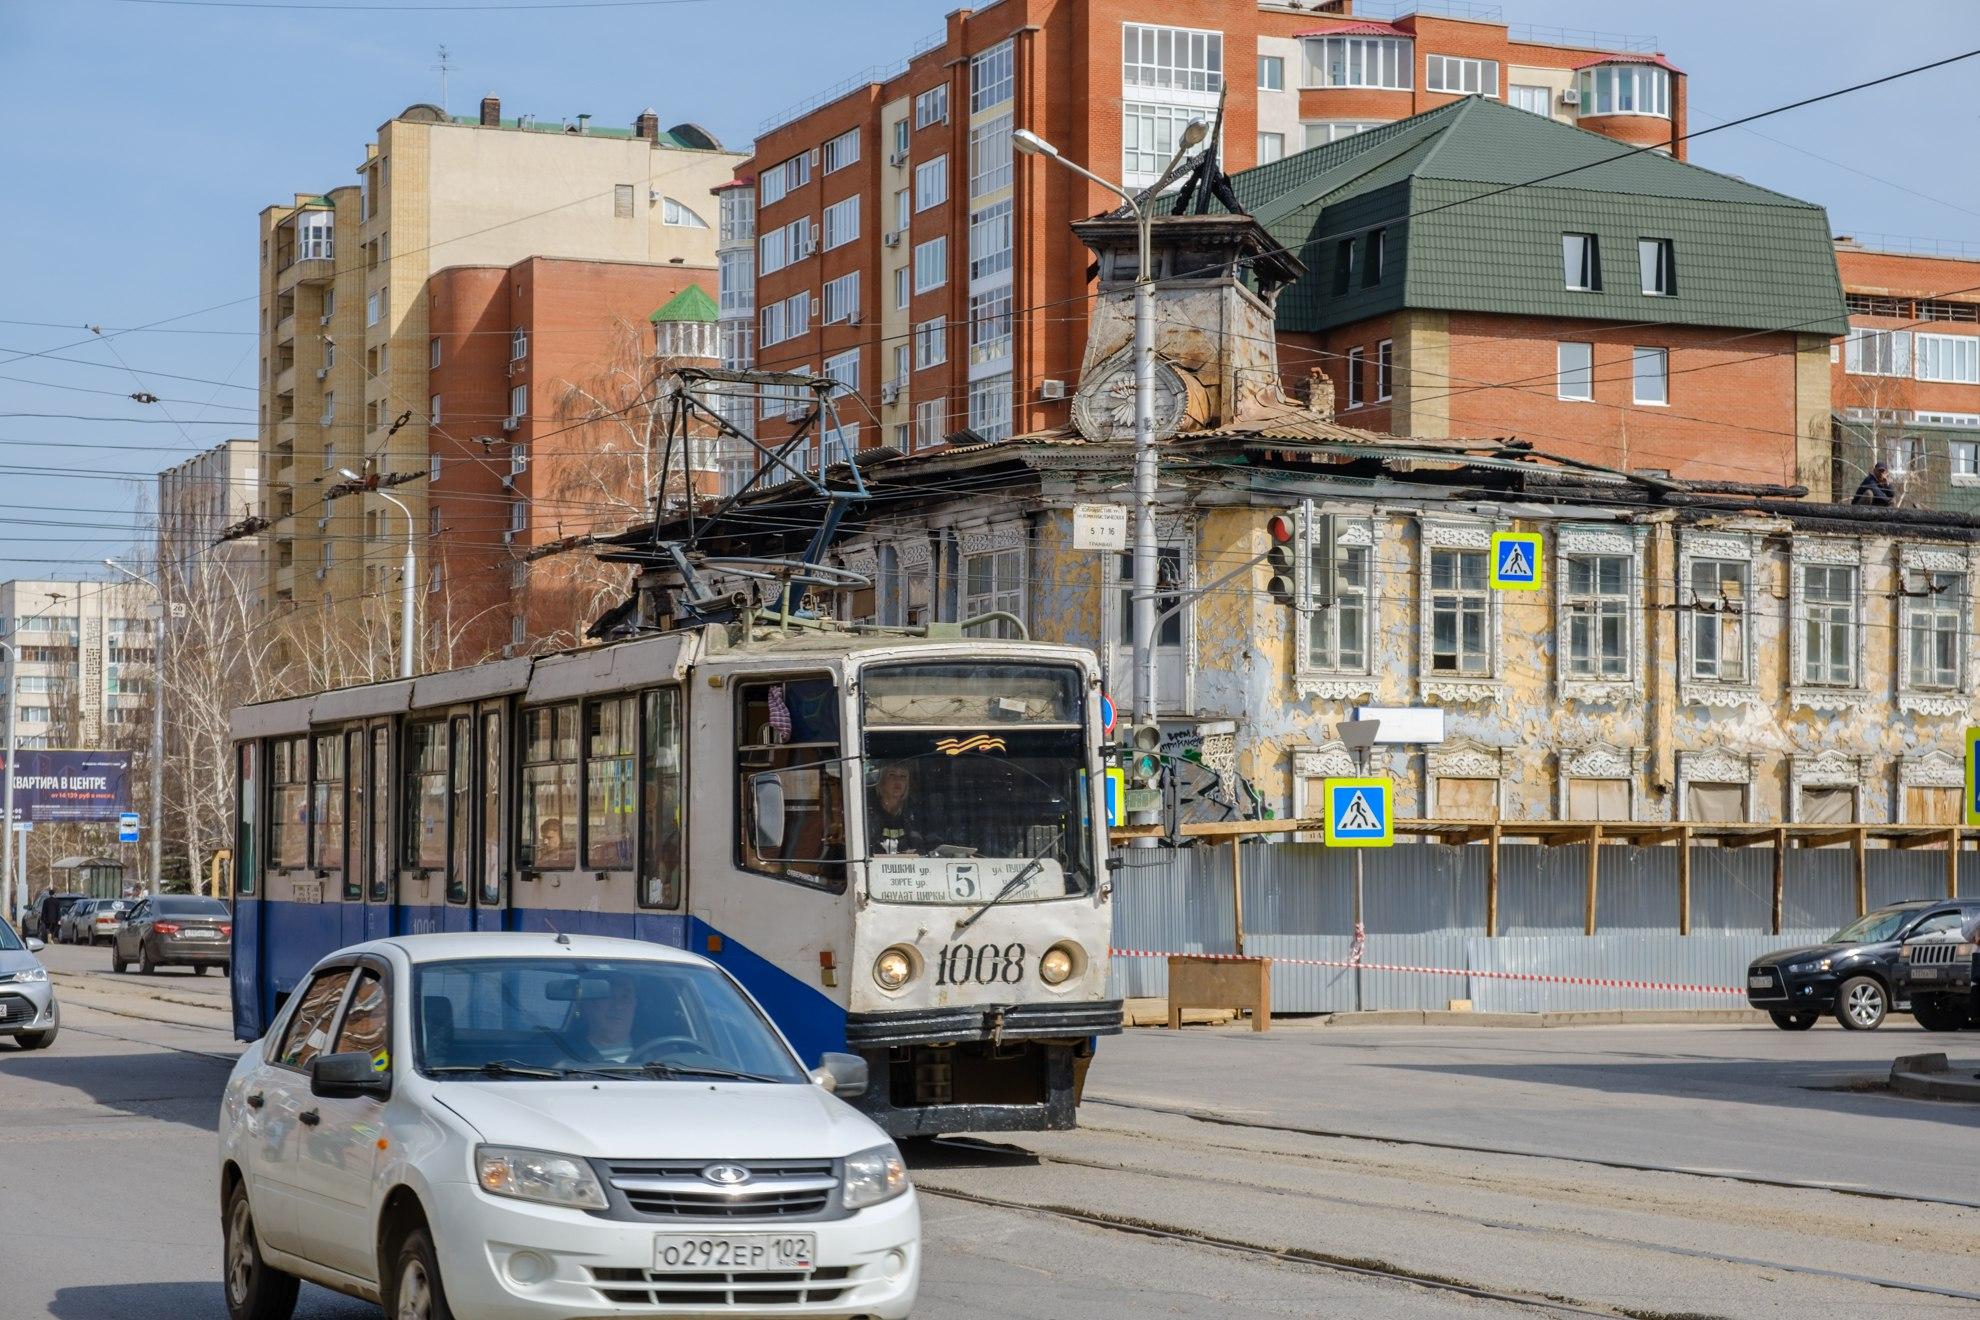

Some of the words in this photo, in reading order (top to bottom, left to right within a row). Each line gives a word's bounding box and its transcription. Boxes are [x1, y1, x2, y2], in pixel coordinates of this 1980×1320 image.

[1090, 527, 1095, 535] 5
[1100, 527, 1105, 535] 7
[61, 776, 67, 789] В
[70, 777, 107, 790] ЦЕНТРЕ
[890, 878, 913, 887] ЗОРГЕ
[956, 866, 975, 898] 5
[935, 942, 1027, 987] 1008
[664, 1240, 764, 1266] О292ЕР
[771, 1238, 807, 1258] 102
